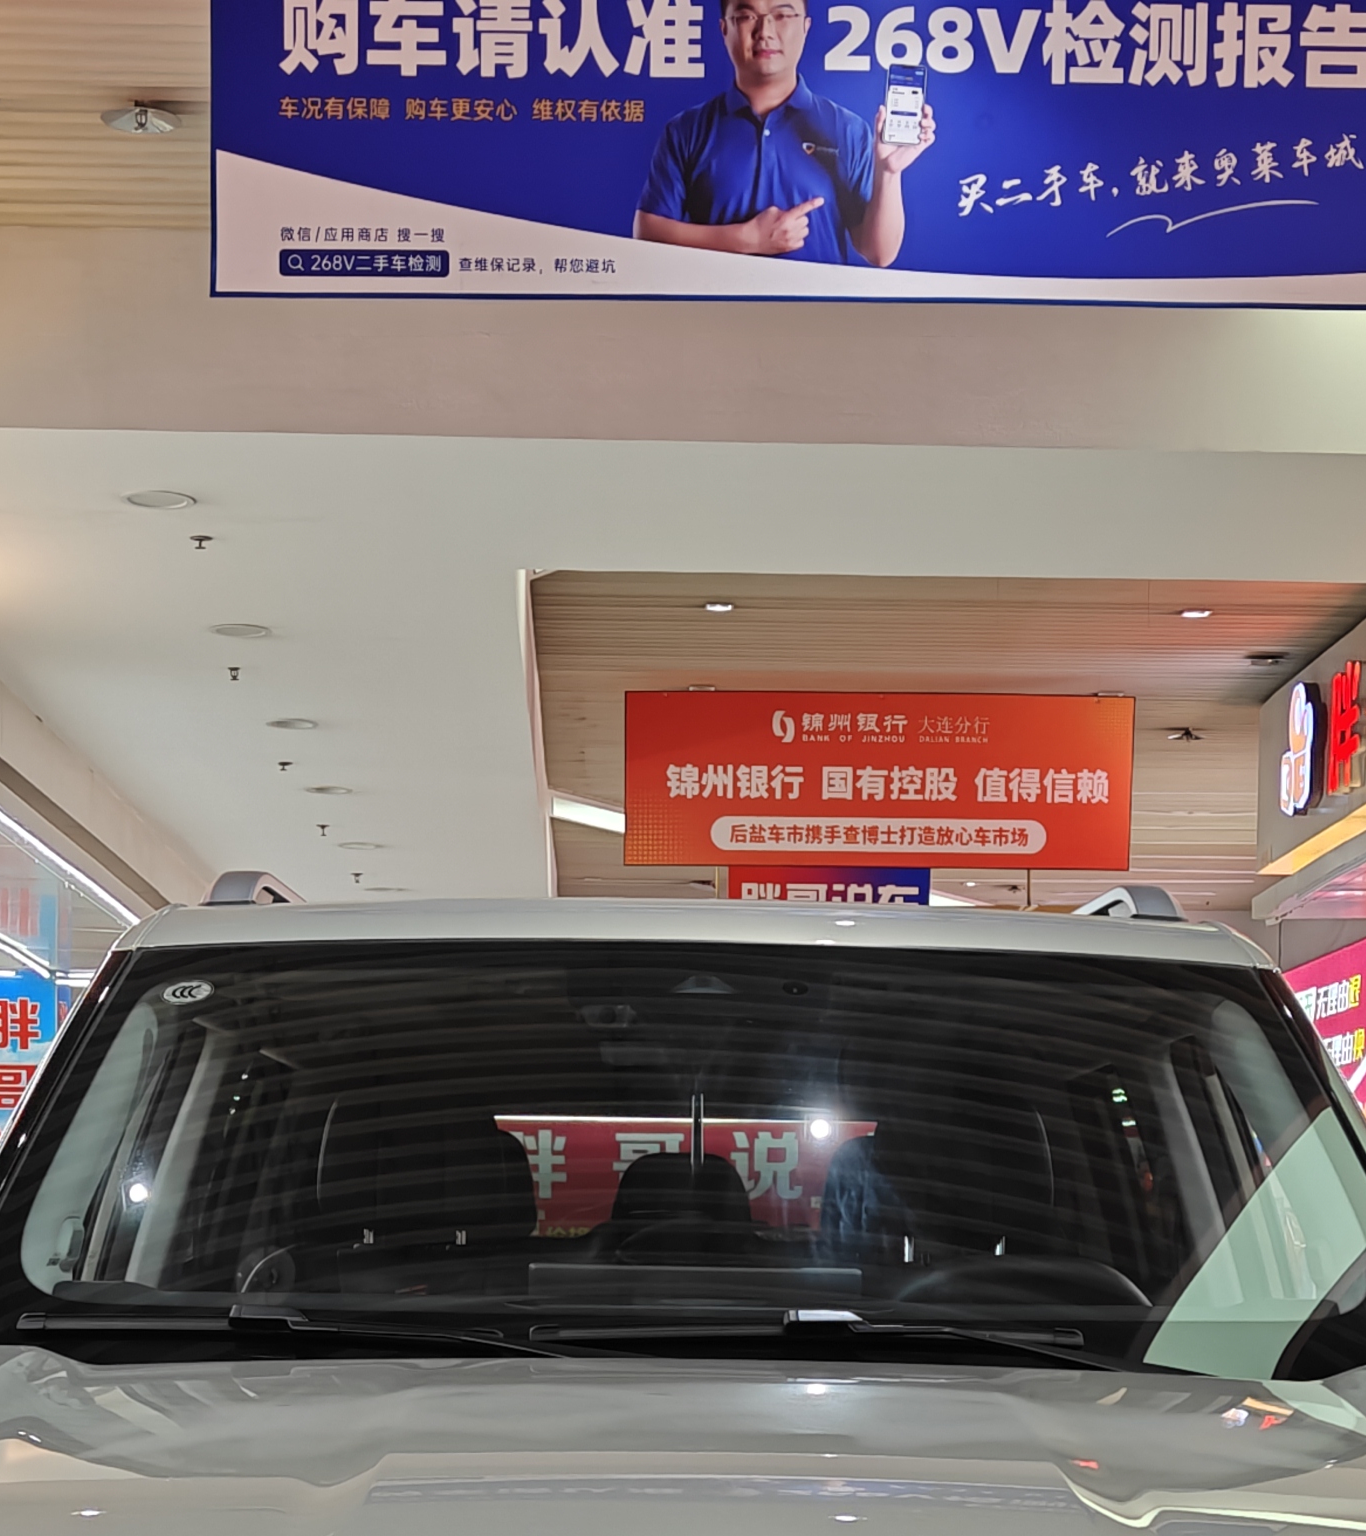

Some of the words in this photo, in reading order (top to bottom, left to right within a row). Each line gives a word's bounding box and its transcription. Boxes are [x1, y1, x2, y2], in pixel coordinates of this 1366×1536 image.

[278, 0, 706, 80] 购车请认准
[278, 96, 392, 121] 车况有保障
[404, 96, 518, 122] 购车更安心
[531, 97, 646, 123] 维权有依据
[279, 225, 390, 244] 微信/应用商店
[396, 226, 446, 244] 搜一搜
[309, 253, 443, 274] 268V二手车检测
[800, 712, 909, 735] 锦州银行
[917, 715, 991, 735] 大连分行
[801, 734, 831, 743] BANK
[838, 734, 853, 743] OF
[861, 734, 906, 743] JINZHOU
[918, 735, 951, 744] DALIAN
[954, 736, 990, 744] BRANCH
[665, 763, 806, 801] 锦州银行
[821, 765, 958, 802] 国有控股
[974, 767, 1110, 805] 值得信赖
[728, 823, 1030, 848] 后盐车市携手查博士打造放心车市场
